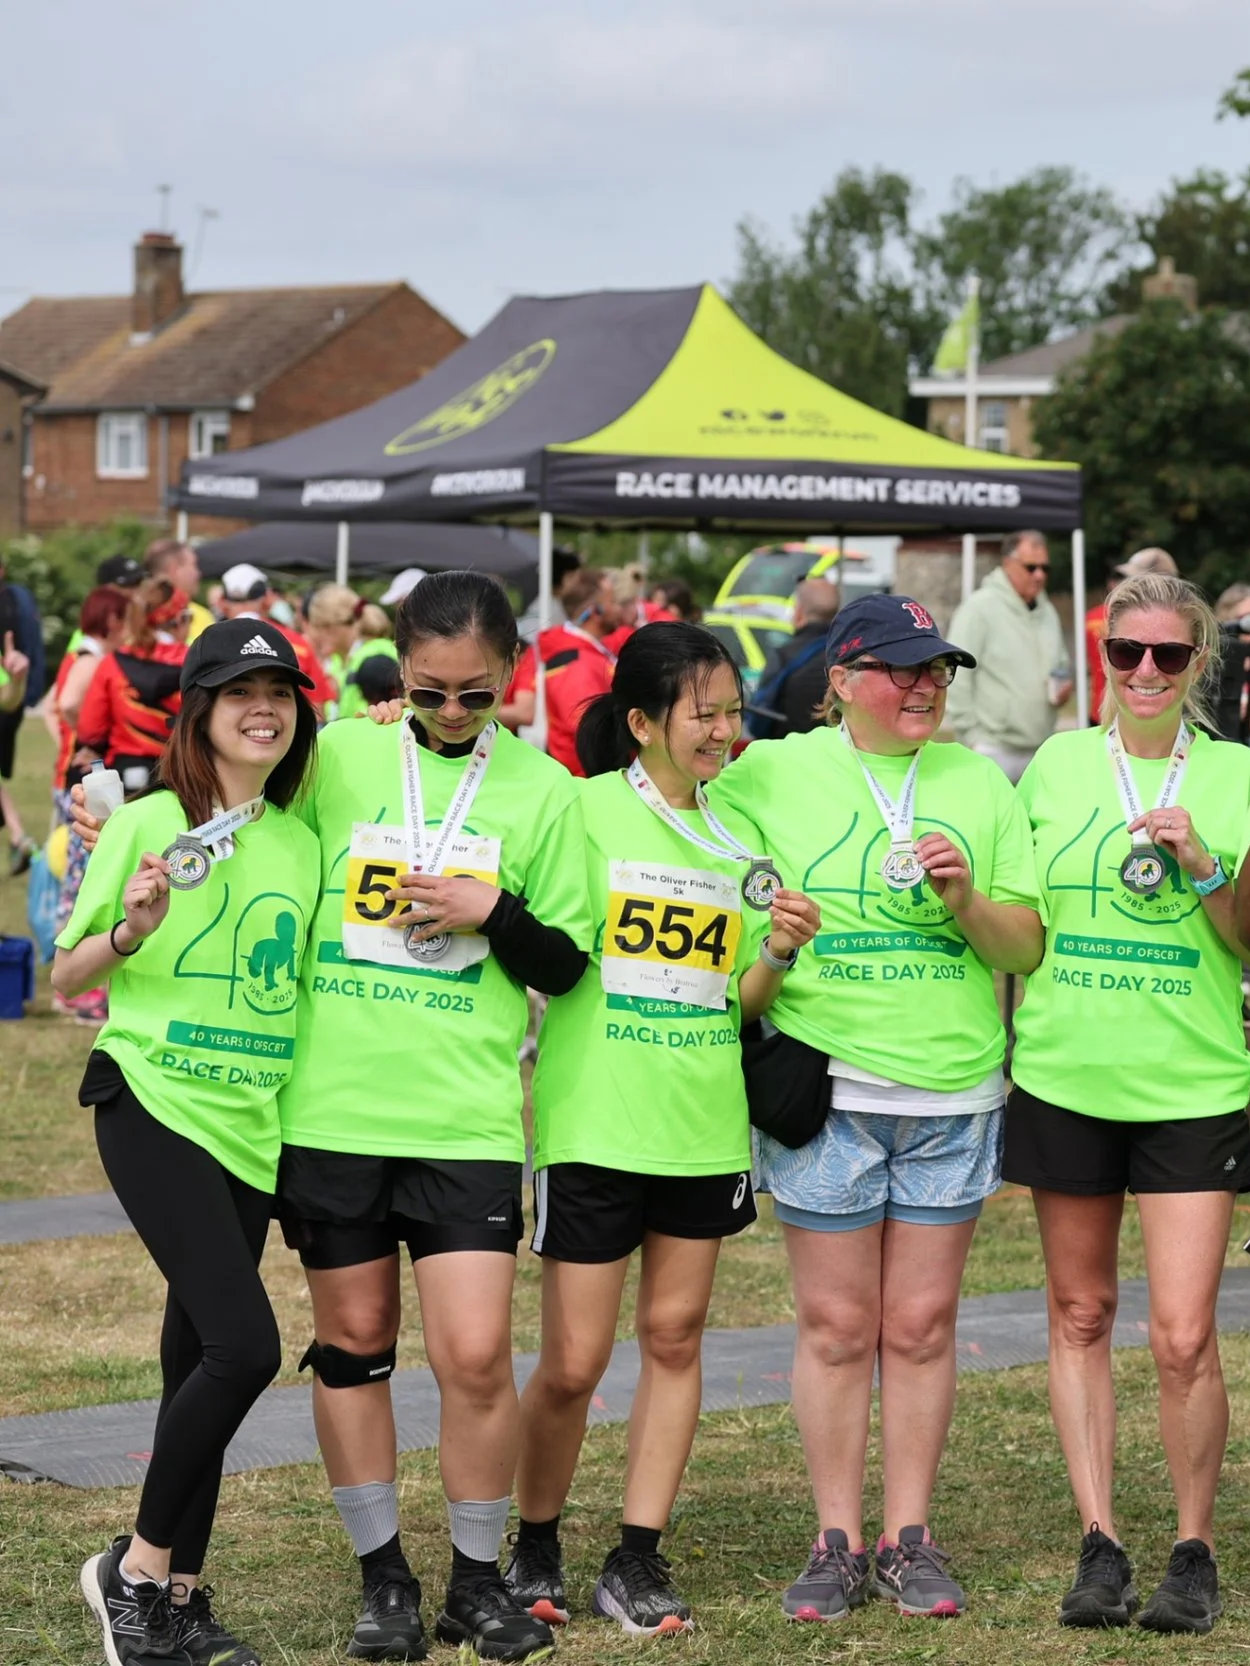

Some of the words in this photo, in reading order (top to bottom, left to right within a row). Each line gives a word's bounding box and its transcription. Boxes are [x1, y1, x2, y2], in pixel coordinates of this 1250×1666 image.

[616, 472, 694, 498] RACE
[698, 473, 892, 504] MANAGEMENT
[895, 478, 1021, 508] SERVICES
[240, 647, 278, 657] adidas
[1116, 756, 1128, 776] OLIVER
[1122, 775, 1133, 797] FISHER
[428, 848, 444, 873] OLIVER
[438, 822, 452, 849] FISHER
[449, 803, 462, 824] RACE
[457, 787, 469, 805] DAY
[464, 771, 476, 789] 2025
[384, 835, 402, 845] The
[640, 872, 657, 882] The
[660, 875, 687, 887] Oliver
[690, 879, 717, 891] Fisher
[674, 887, 684, 896] 5k
[887, 897, 911, 915] 1985
[1120, 892, 1144, 911] 1985
[1156, 900, 1181, 914] 2025
[614, 898, 728, 967] 554
[832, 939, 847, 949] 40
[851, 937, 891, 947] YEARS
[895, 937, 910, 946] OF
[1063, 940, 1074, 950] 40
[1078, 942, 1112, 954] YEARS
[1117, 946, 1132, 956] OF
[1137, 948, 1181, 961] OFSCBT
[818, 964, 874, 981] RACE
[882, 964, 927, 981] DAY
[931, 964, 966, 981] 2025
[1053, 967, 1092, 988] RACE
[1100, 973, 1145, 992] DAY
[1151, 978, 1192, 996] 2025
[312, 976, 365, 998] RACE
[373, 983, 419, 1003] DAY
[424, 992, 474, 1013] 2025
[639, 1003, 676, 1013] YEARS
[189, 1030, 204, 1042] 40
[210, 1033, 243, 1048] YEARS
[254, 1039, 286, 1053] OFSCBT
[606, 1023, 663, 1046] RACE
[668, 1031, 706, 1048] DAY
[709, 1028, 737, 1046] 2025
[161, 1052, 223, 1081] RACE
